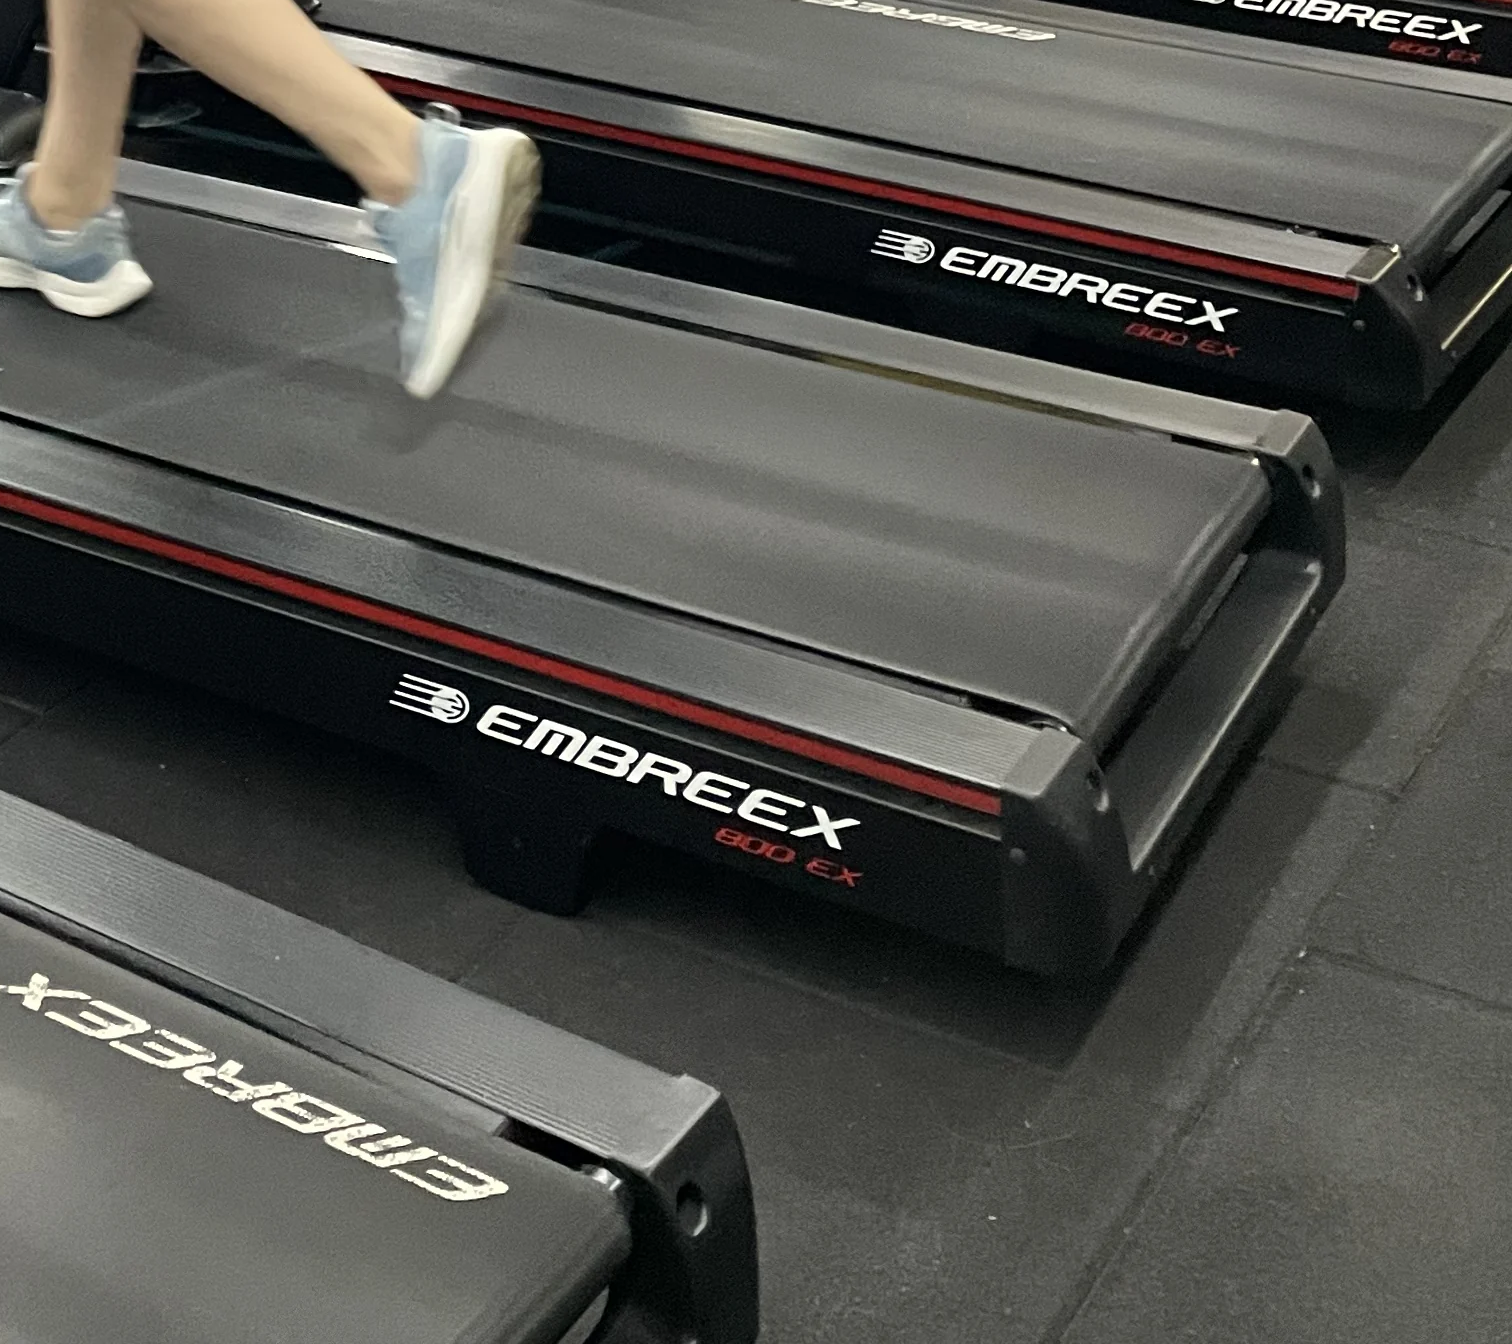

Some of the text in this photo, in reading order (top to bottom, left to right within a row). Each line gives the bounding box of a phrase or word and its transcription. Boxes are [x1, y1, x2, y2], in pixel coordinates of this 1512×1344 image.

[938, 245, 1240, 334] EMBREEX
[1195, 338, 1242, 359] EX
[474, 702, 862, 852] EMBREEX
[713, 825, 864, 889] 800 EX
